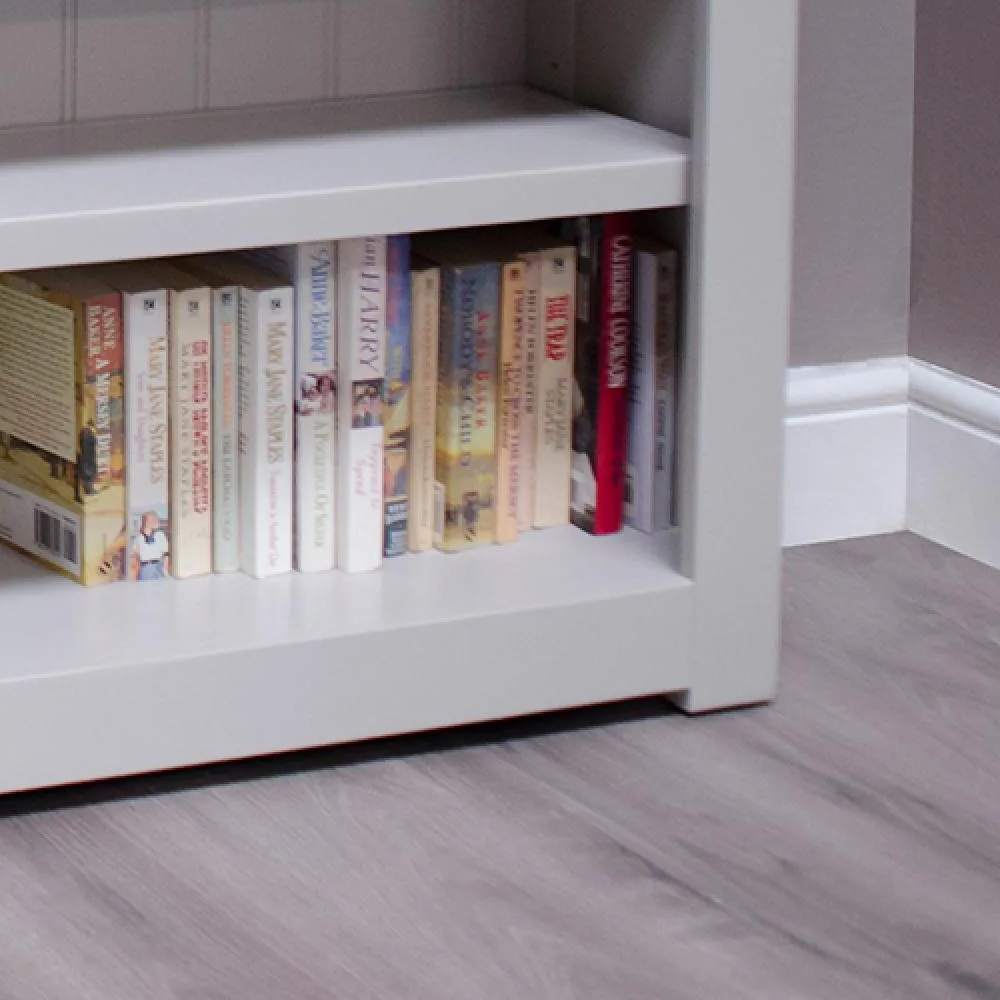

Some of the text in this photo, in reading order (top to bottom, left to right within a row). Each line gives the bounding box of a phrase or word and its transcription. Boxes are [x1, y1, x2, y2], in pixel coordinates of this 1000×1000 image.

[86, 305, 102, 360] BAKER
[102, 306, 117, 351] ANNE
[359, 236, 382, 374] ian HARRY
[543, 293, 570, 361] THE TRAP
[607, 234, 632, 389] CATHERINE COOKSON
[95, 358, 111, 370] A
[266, 321, 288, 364] MARY
[94, 371, 111, 429] MERSEY
[265, 368, 287, 401] JANE
[457, 278, 477, 468] NOBODY'S CHILD
[474, 369, 490, 429] BAKER
[146, 335, 168, 485] MARY JANE STAPLES
[266, 404, 288, 465] STAPLES
